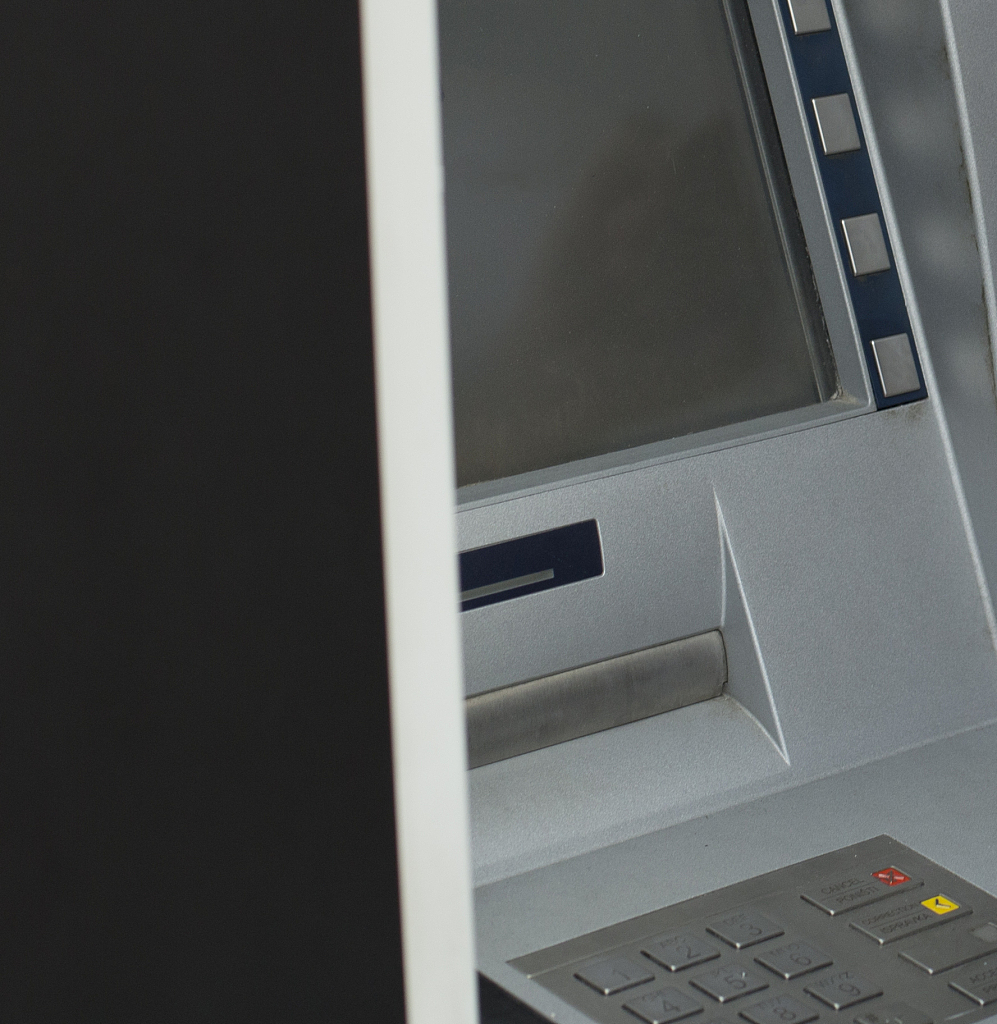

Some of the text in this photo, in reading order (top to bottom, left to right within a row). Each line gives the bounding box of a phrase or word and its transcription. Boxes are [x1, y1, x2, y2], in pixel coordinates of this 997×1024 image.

[821, 878, 866, 894] CANCEL
[739, 922, 763, 937] 3
[676, 944, 701, 960] 2
[789, 952, 812, 966] 6
[612, 969, 631, 981] 1
[723, 974, 747, 991] 5
[838, 983, 861, 997] 9
[662, 999, 681, 1013] 4
[773, 1006, 797, 1022] 8
